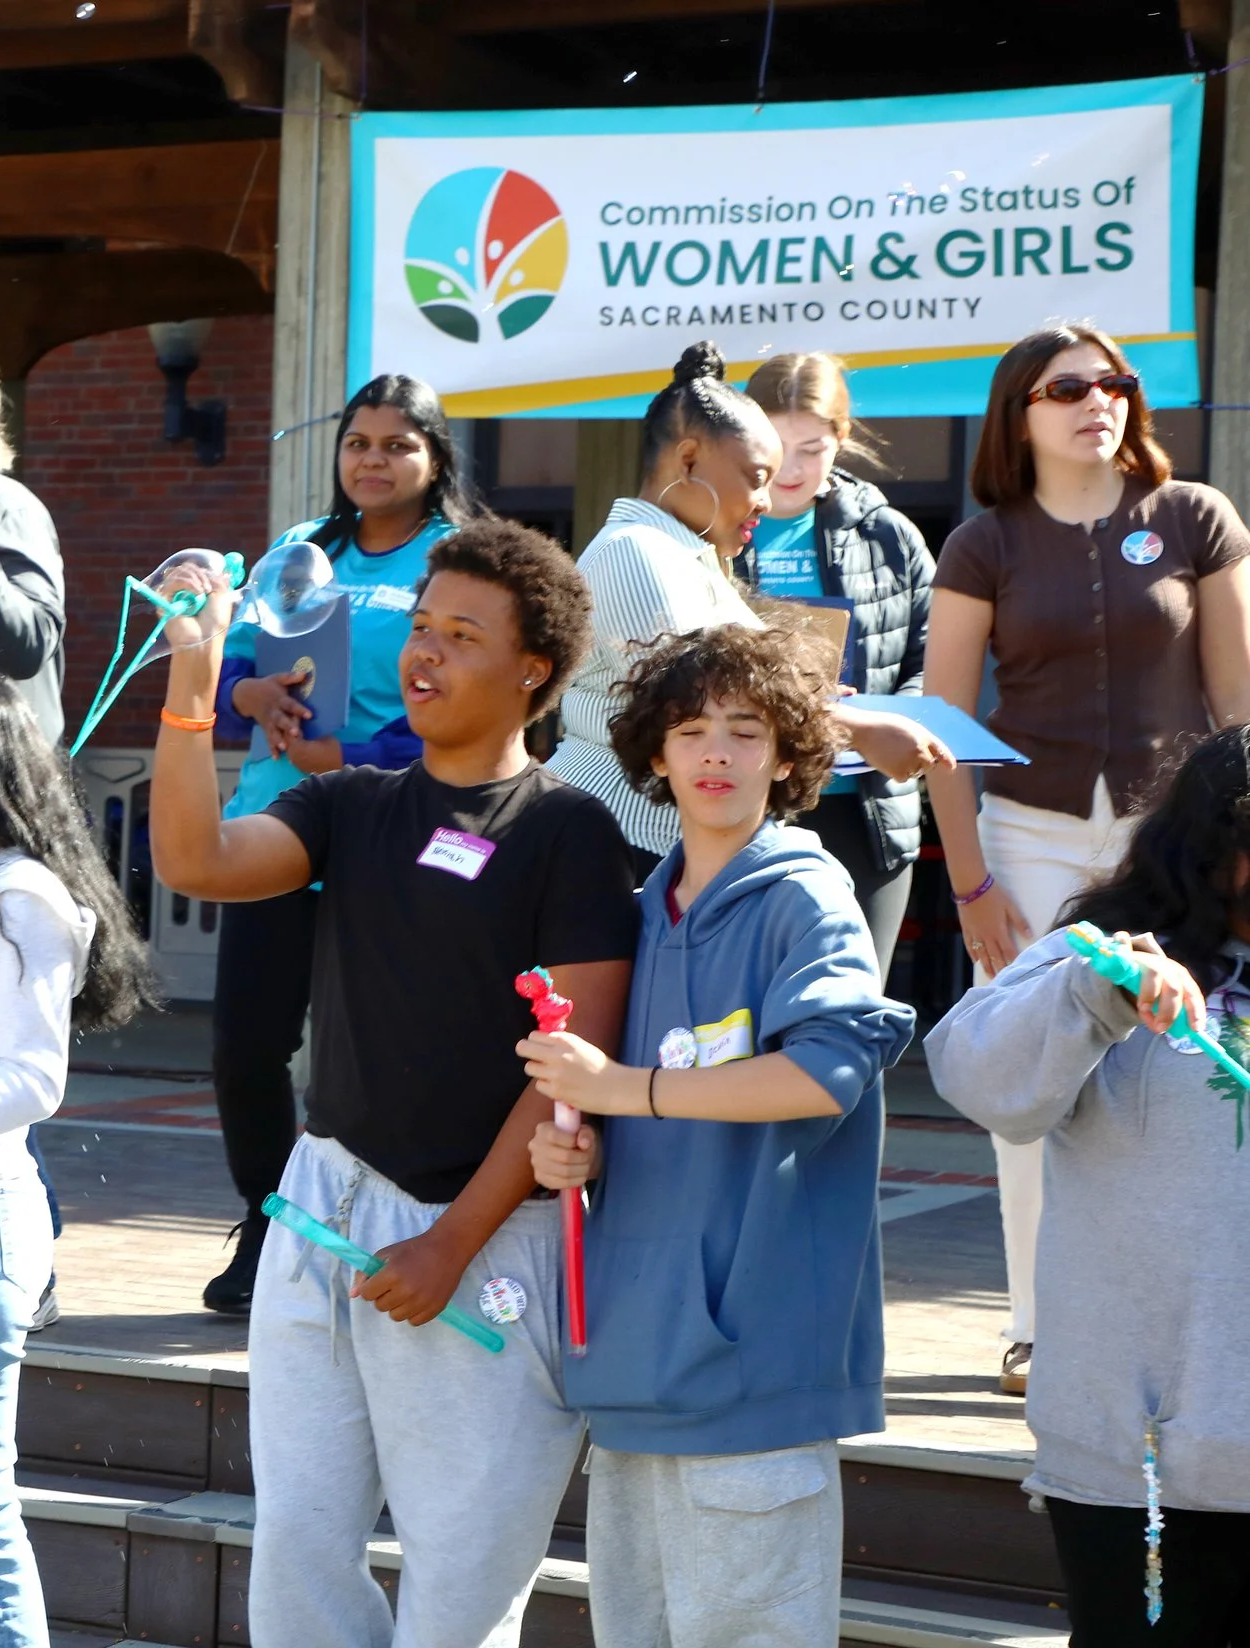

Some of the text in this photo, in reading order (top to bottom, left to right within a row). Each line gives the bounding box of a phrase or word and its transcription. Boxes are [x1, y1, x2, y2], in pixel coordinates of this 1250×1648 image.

[600, 175, 1136, 226] Commission On The Status Of
[598, 221, 1135, 287] WOMEN & GIRLS
[600, 297, 981, 326] SACRAMENTO COUNTY
